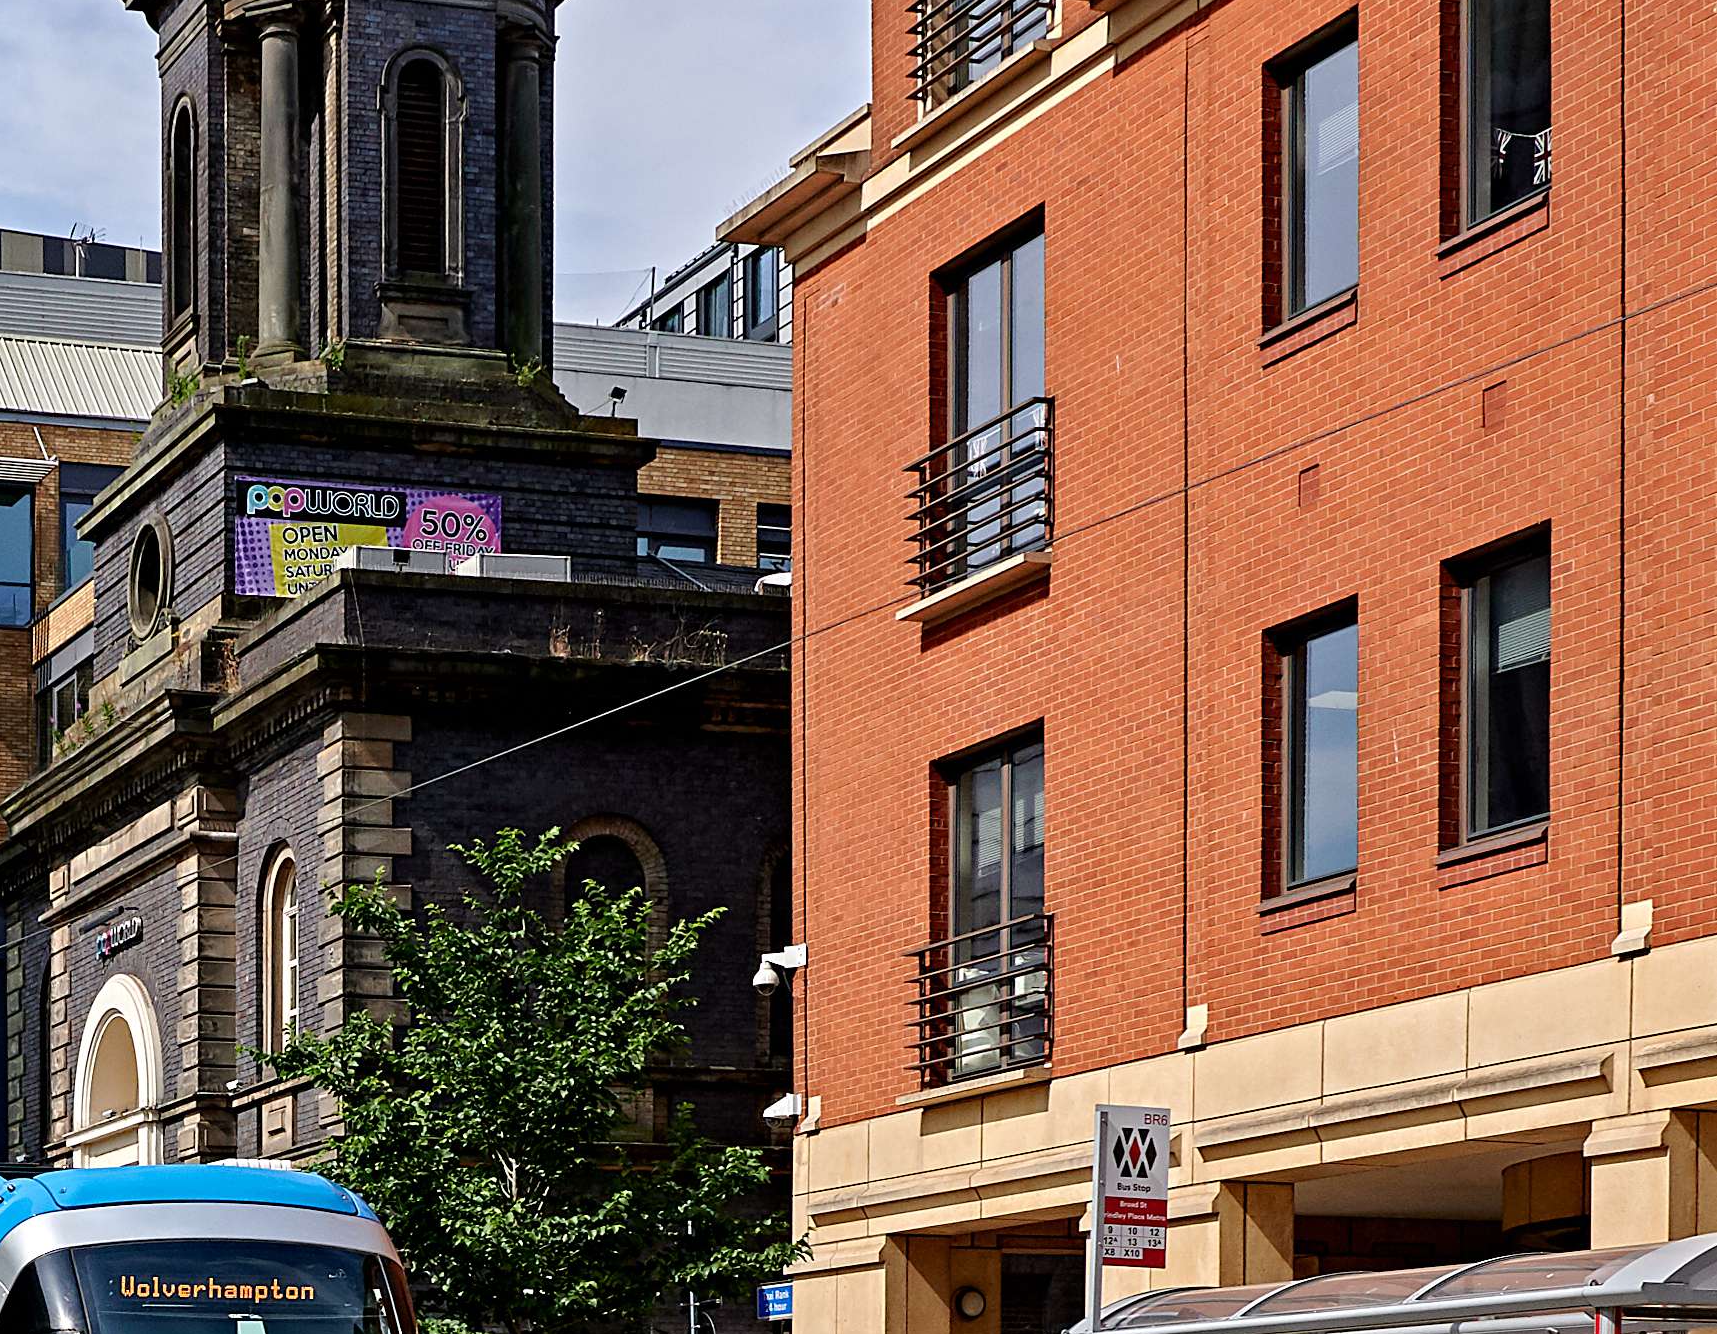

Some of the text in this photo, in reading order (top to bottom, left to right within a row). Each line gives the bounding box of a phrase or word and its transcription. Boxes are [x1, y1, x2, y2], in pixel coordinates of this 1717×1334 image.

[421, 509, 488, 542] 50%
[283, 526, 338, 544] OPEN
[412, 538, 494, 556] OFF FRIDAY
[284, 547, 349, 561] MONDAY
[285, 564, 335, 578] SATUR
[1143, 1113, 1169, 1126] BR6
[1117, 1182, 1151, 1194] Bus Stop
[1104, 1211, 1127, 1220] rindley
[1128, 1227, 1138, 1235] 10
[1149, 1228, 1160, 1237] 12
[1127, 1238, 1138, 1247] 13
[1124, 1249, 1140, 1258] X10
[121, 1275, 315, 1304] Wolverhampton
